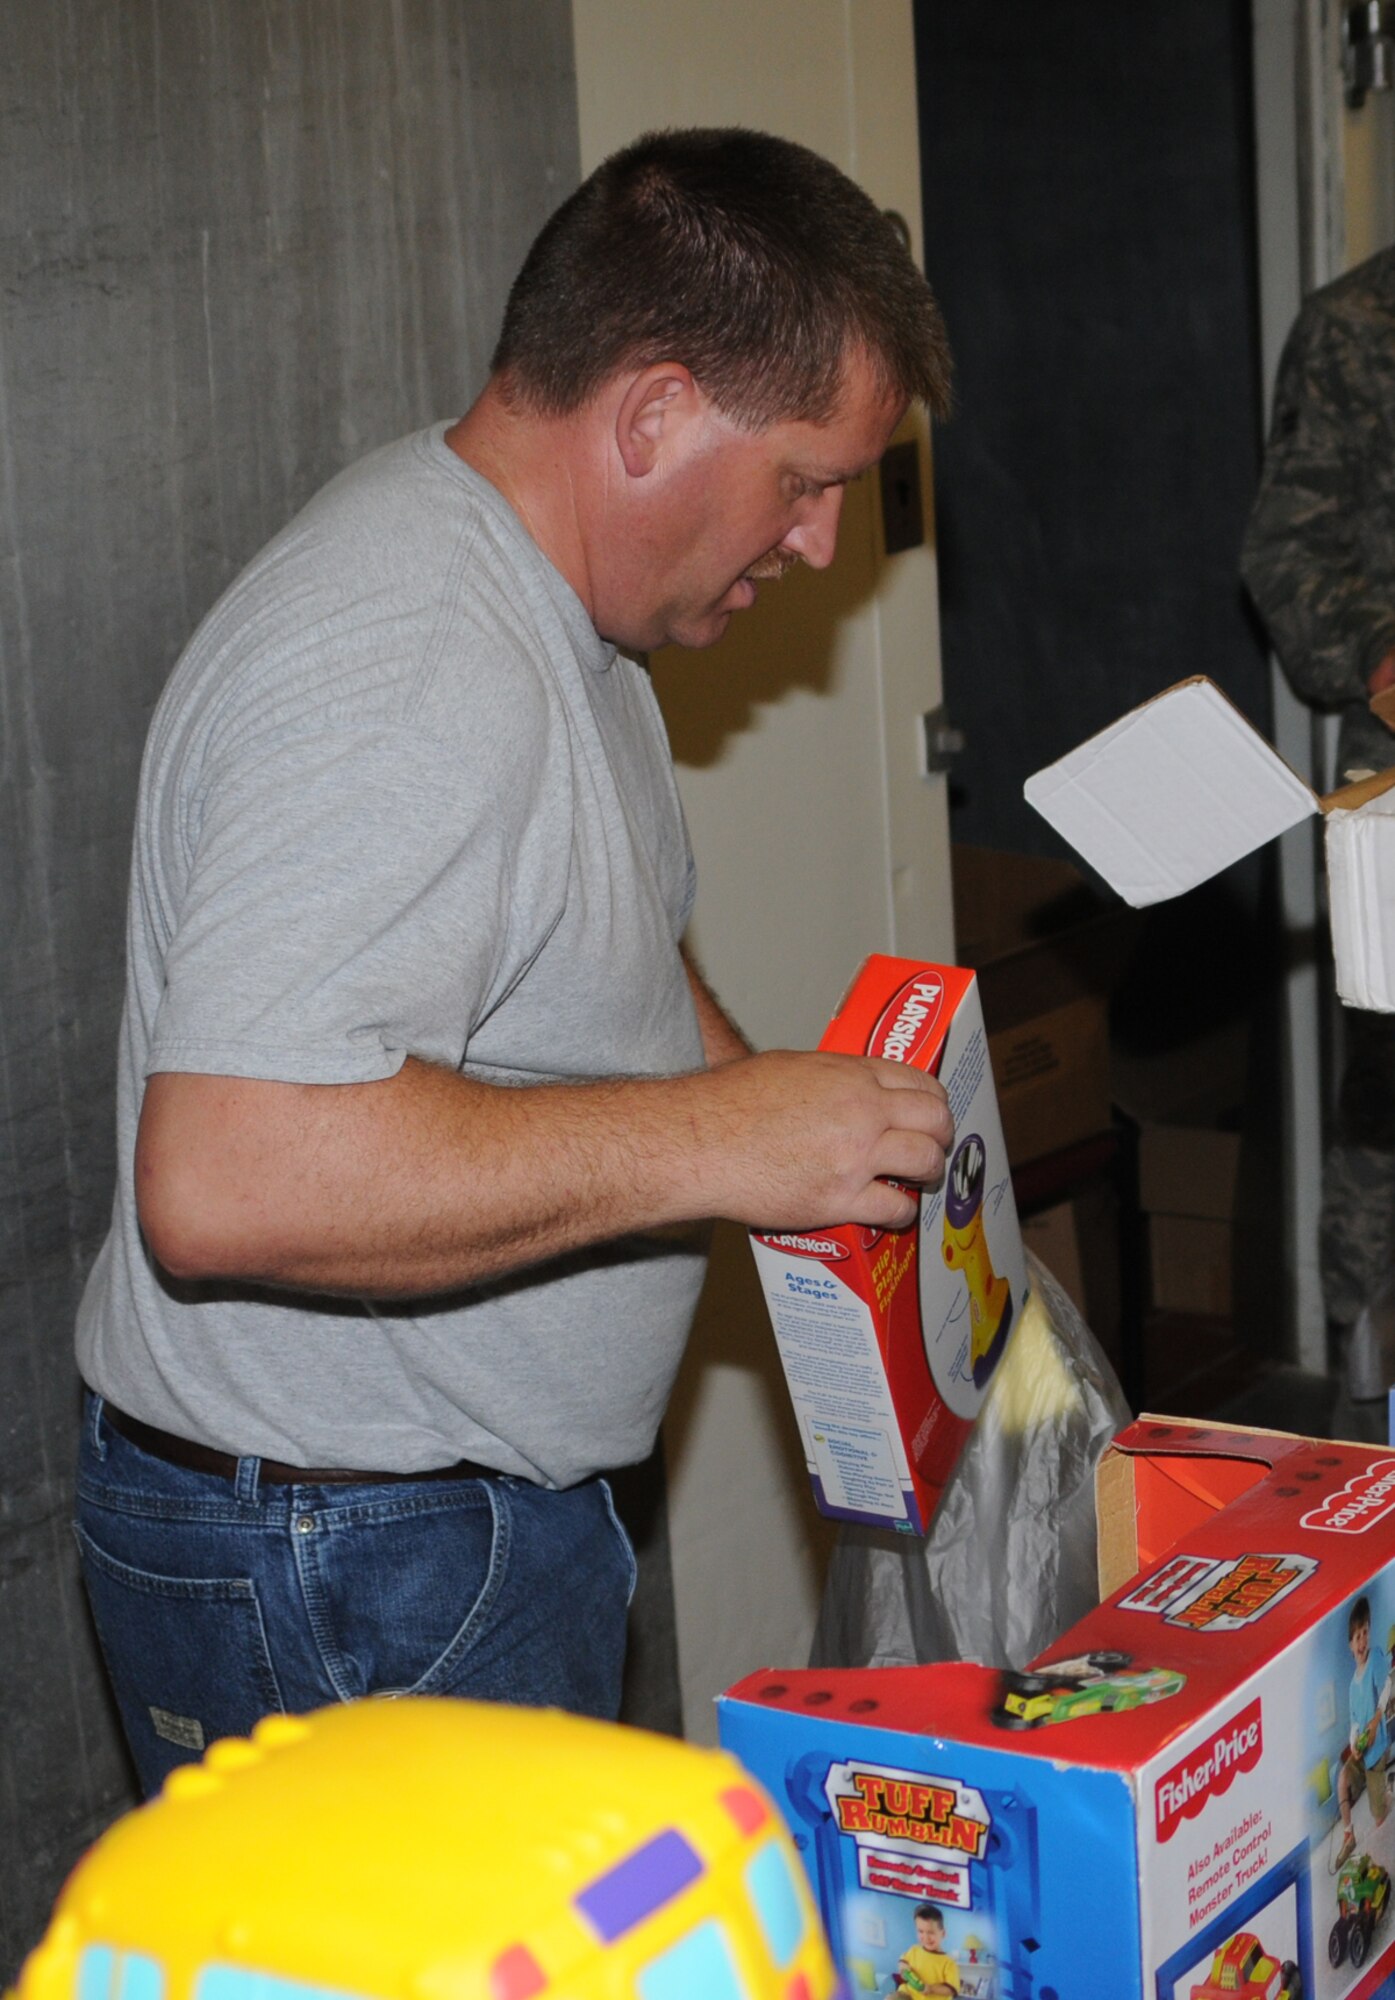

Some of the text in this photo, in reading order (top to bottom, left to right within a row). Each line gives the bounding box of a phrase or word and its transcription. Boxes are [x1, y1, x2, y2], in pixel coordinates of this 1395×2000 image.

[882, 983, 942, 1063] PLAYSKOO
[762, 1234, 842, 1257] PLAYSKOOL
[785, 1272, 821, 1286] Ages
[788, 1283, 838, 1299] Stages
[855, 1775, 955, 1823] TUFF
[1158, 1721, 1259, 1824] Fisher-Price
[1187, 1810, 1263, 1882] Also Available:
[1188, 1821, 1272, 1905] Remote Control
[1190, 1847, 1268, 1929] Monster Truck!
